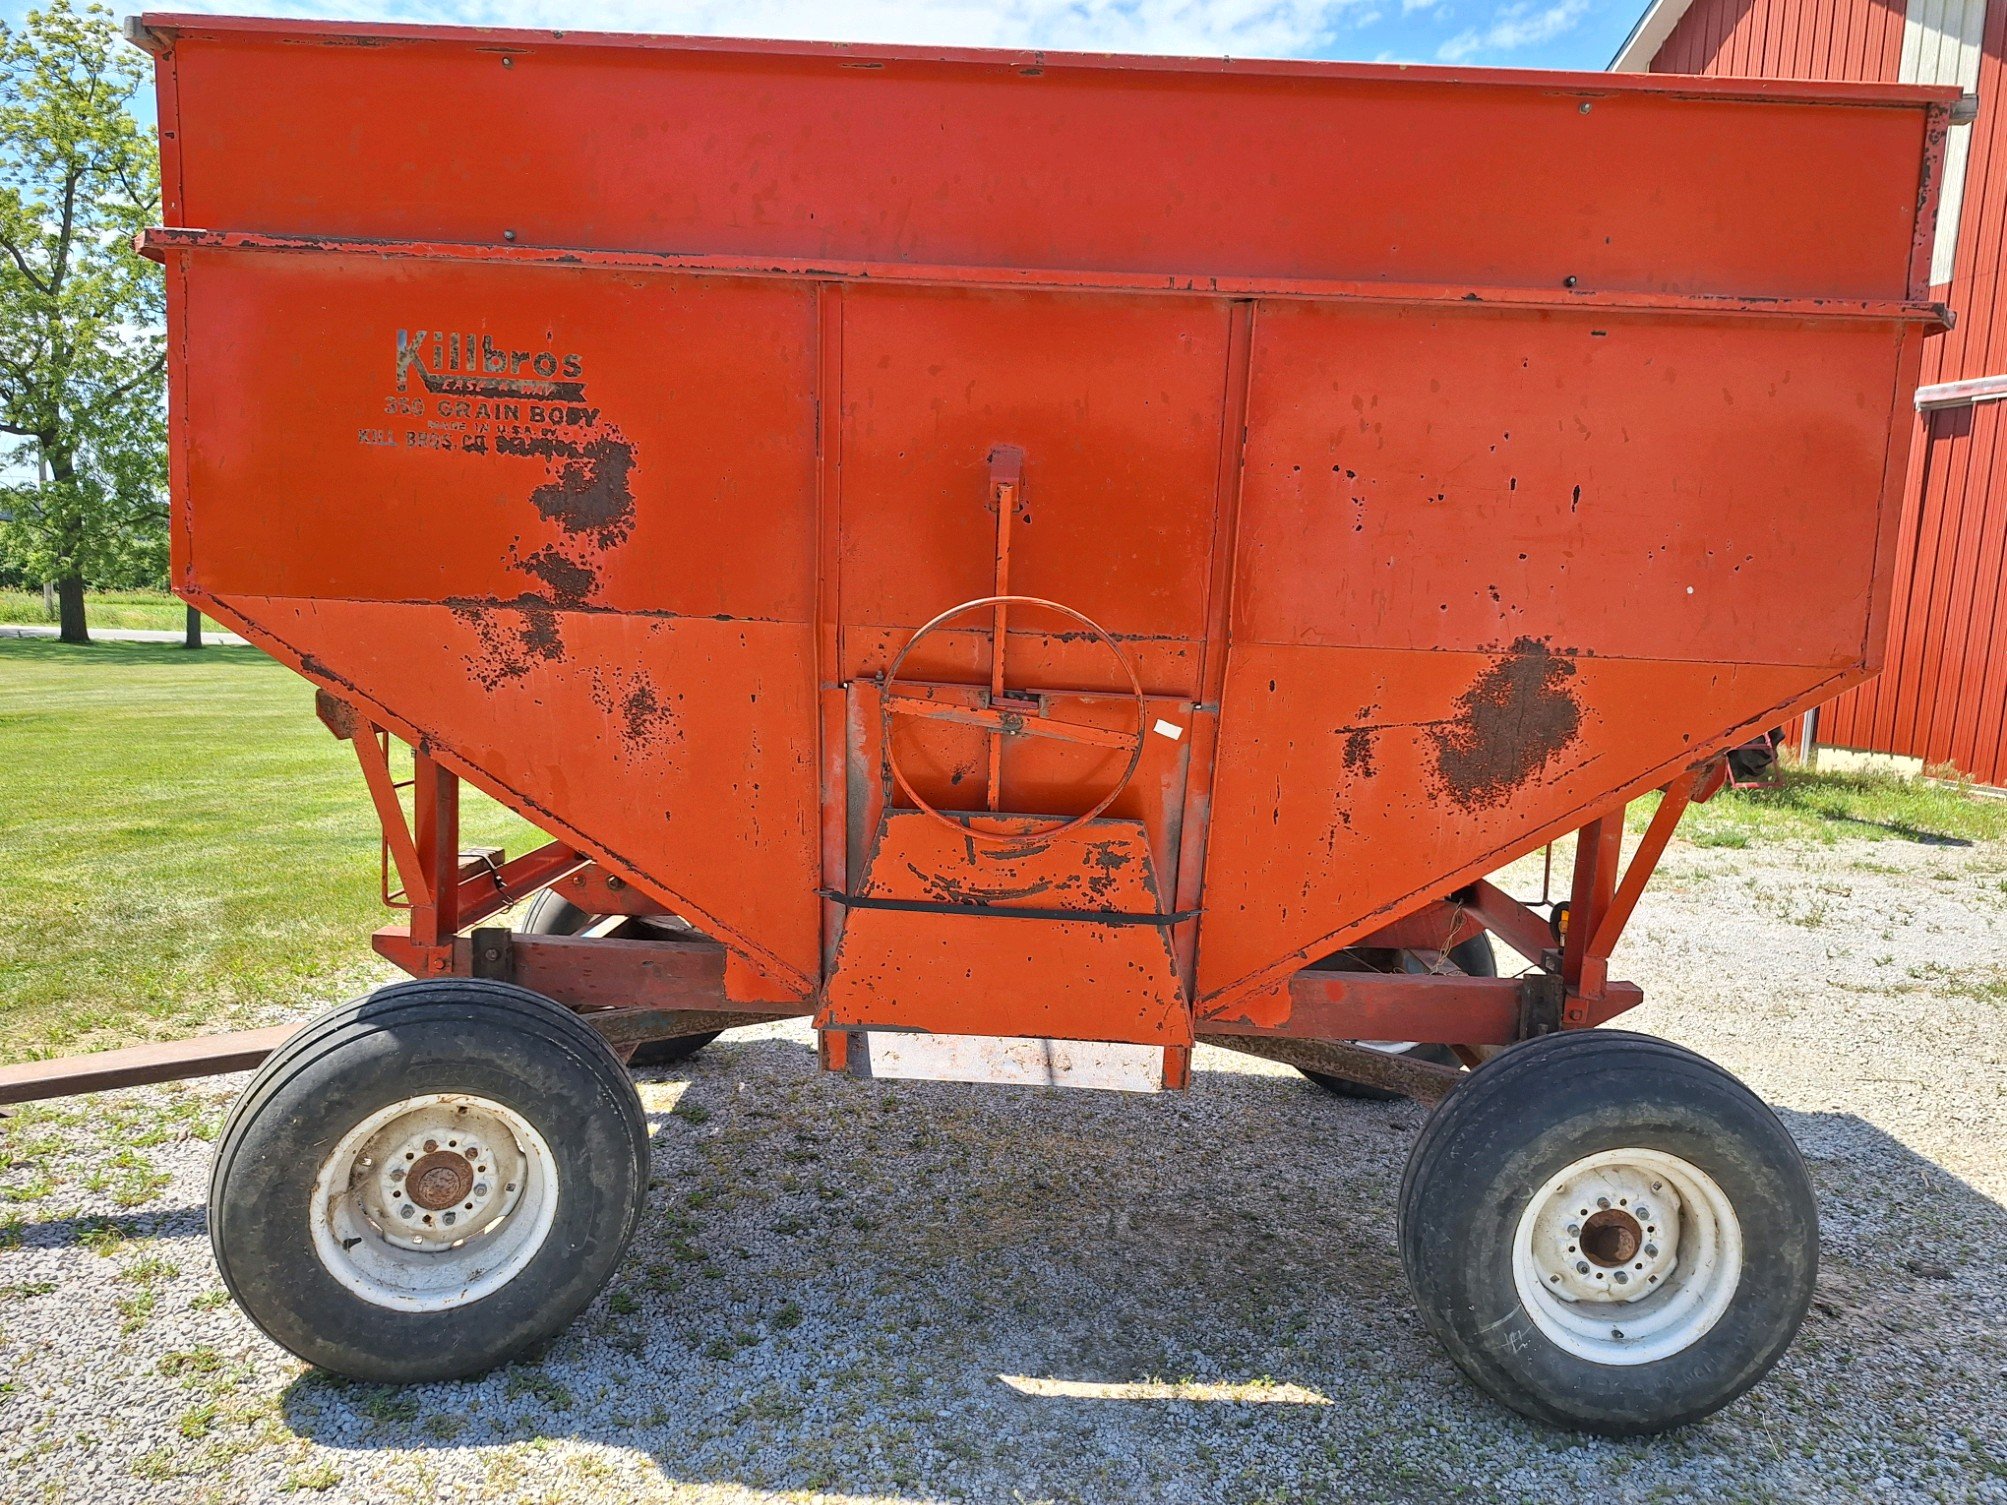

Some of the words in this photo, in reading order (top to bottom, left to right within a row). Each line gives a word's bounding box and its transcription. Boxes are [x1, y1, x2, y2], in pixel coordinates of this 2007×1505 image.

[396, 328, 584, 392] Killbros
[437, 400, 519, 421] GRAIN
[529, 405, 601, 427] BODY
